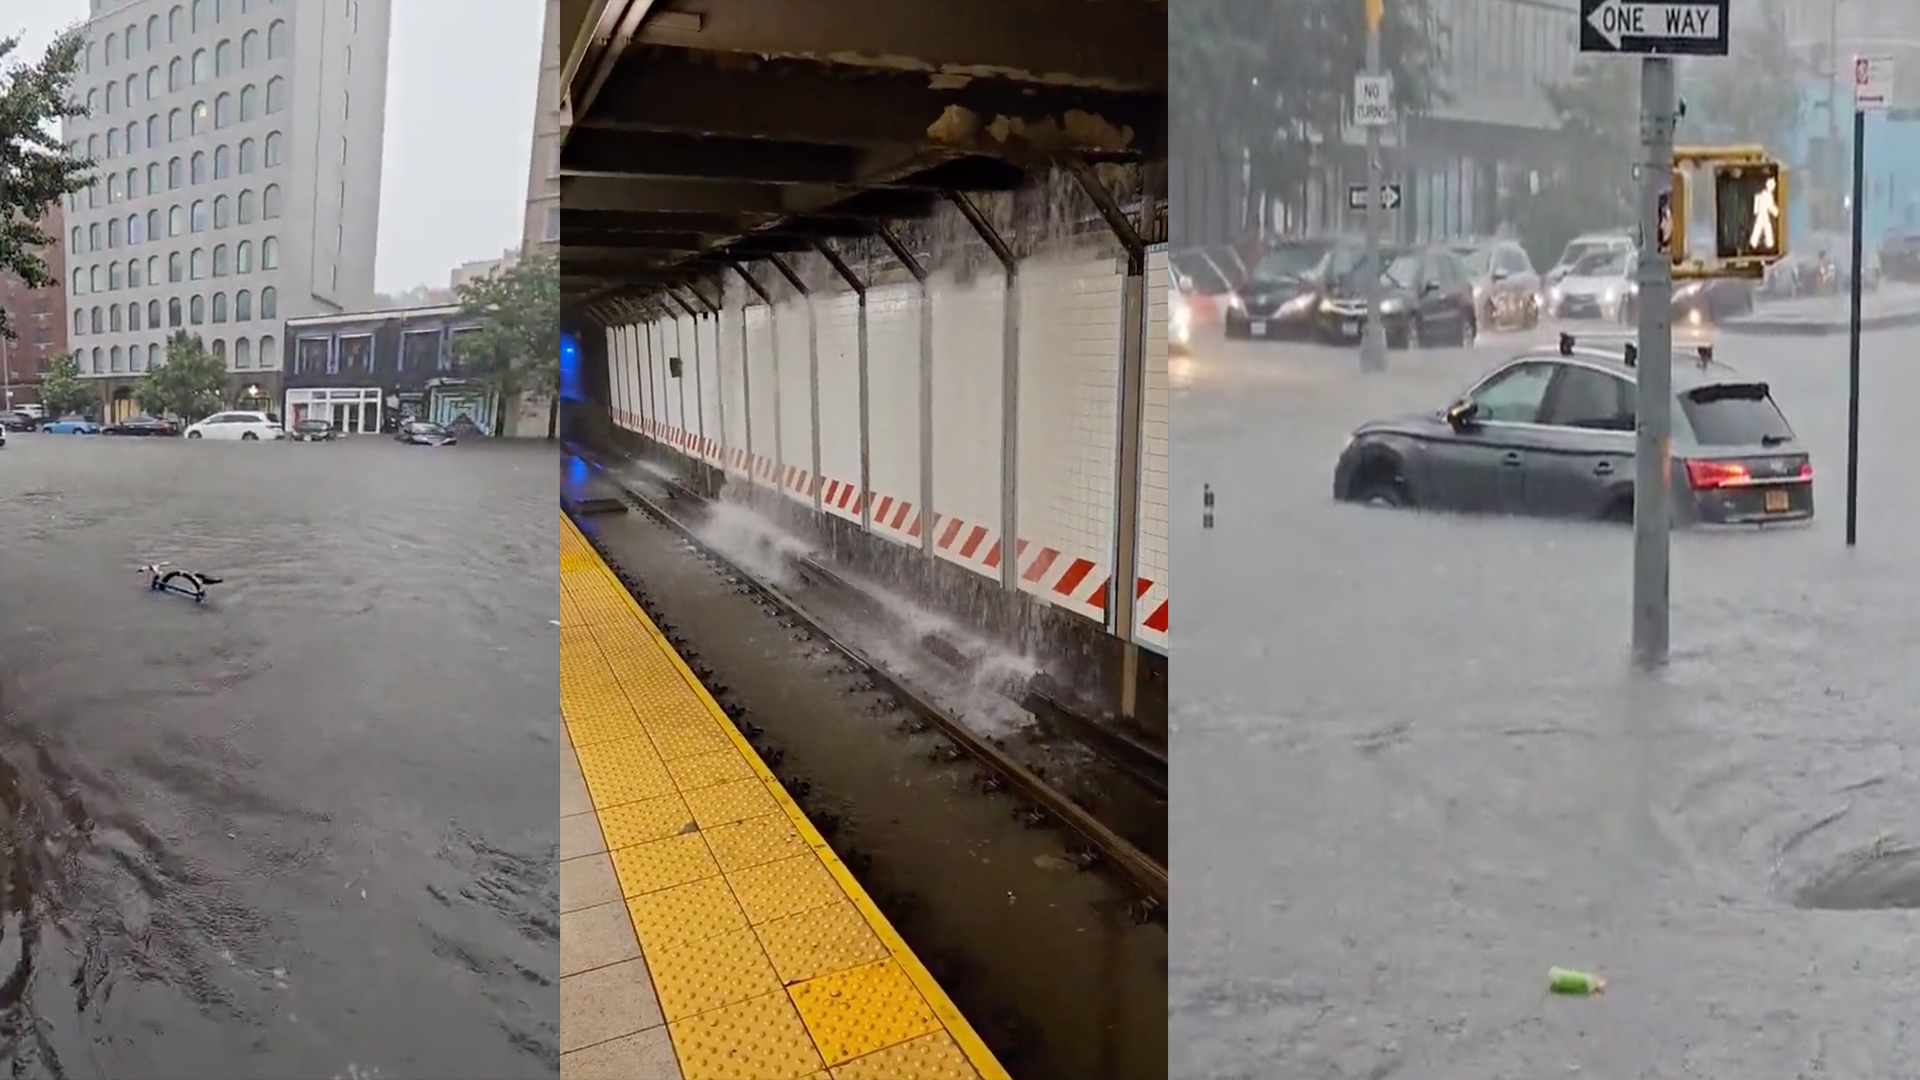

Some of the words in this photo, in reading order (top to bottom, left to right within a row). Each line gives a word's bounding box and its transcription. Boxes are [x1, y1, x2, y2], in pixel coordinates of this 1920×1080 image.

[1603, 6, 1644, 32] ONE
[1665, 8, 1710, 34] WAY
[1364, 83, 1380, 99] NO
[1357, 104, 1386, 119] TURNS
